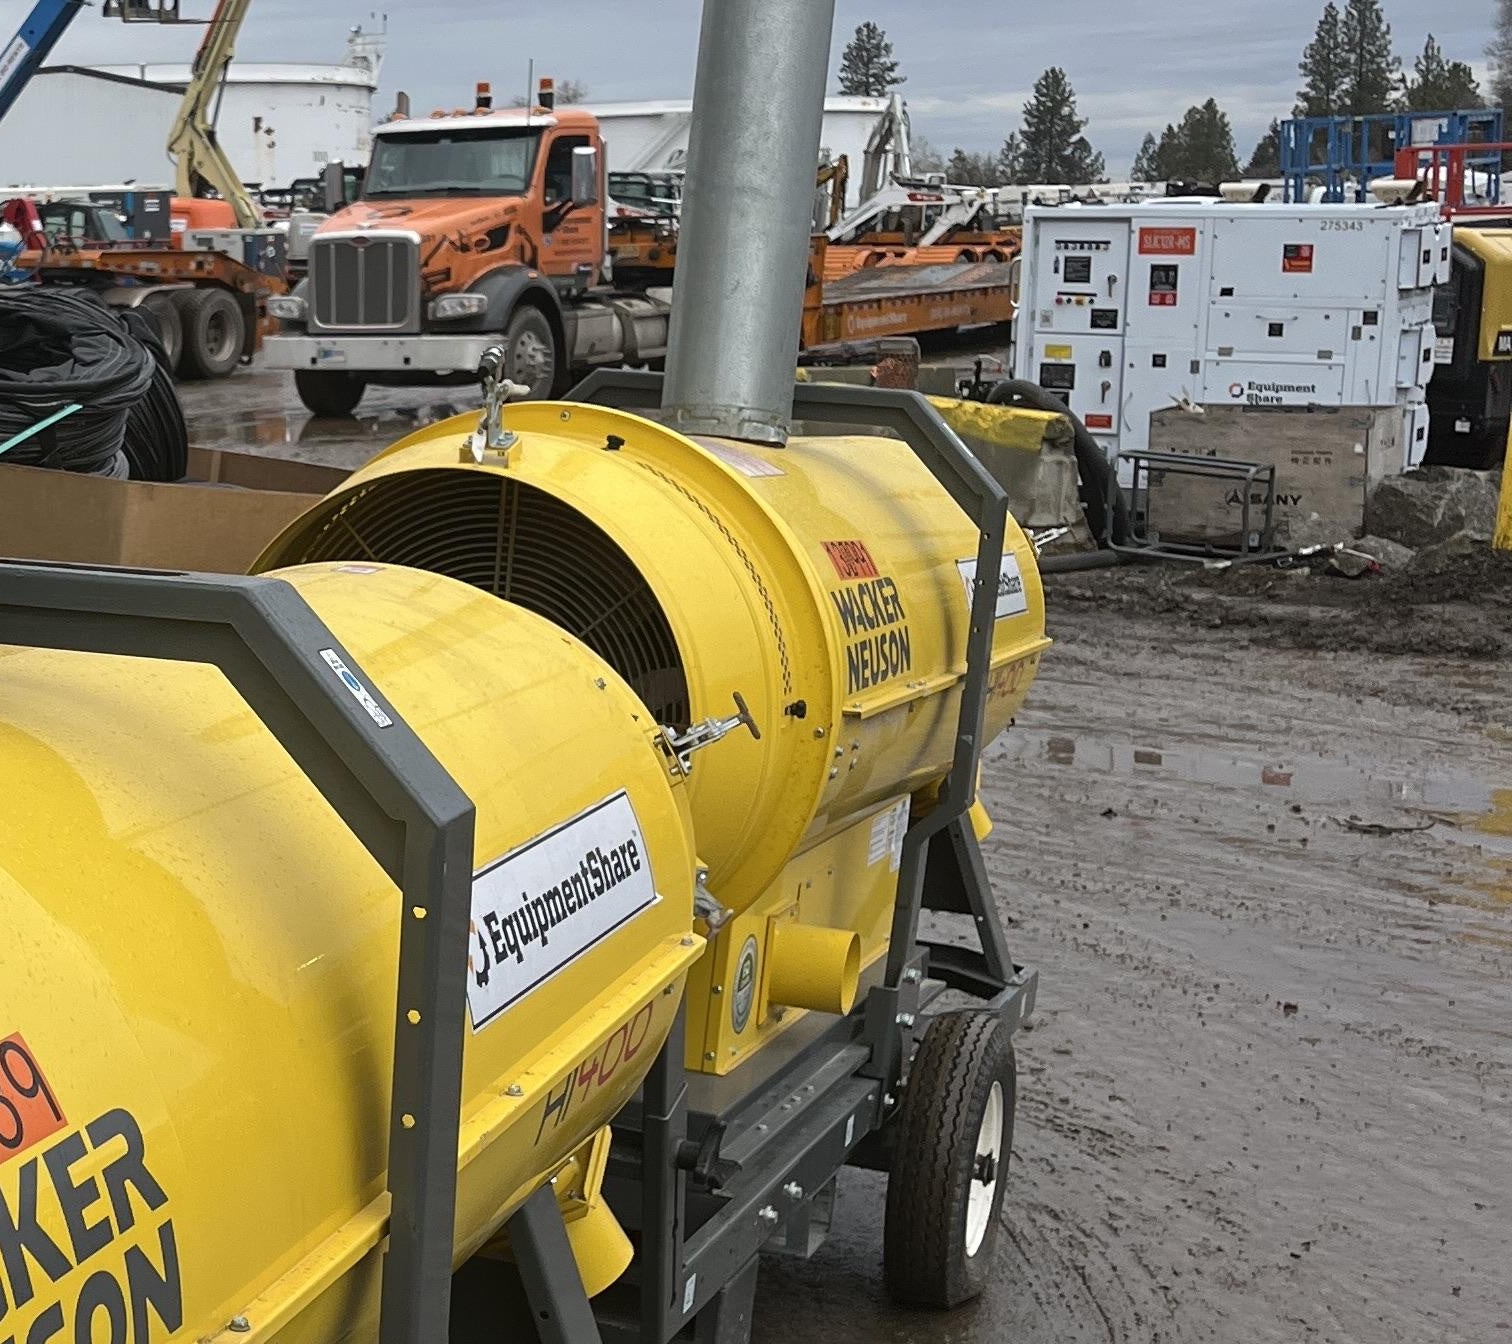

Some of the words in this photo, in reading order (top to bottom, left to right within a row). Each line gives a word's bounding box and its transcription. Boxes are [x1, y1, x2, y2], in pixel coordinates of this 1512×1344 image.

[1319, 220, 1364, 232] 275343
[1247, 381, 1316, 394] Equipment
[1247, 393, 1283, 405] Share
[830, 576, 906, 638] WACKER
[846, 625, 911, 696] NEUSON
[482, 837, 642, 965] EquipmentShare
